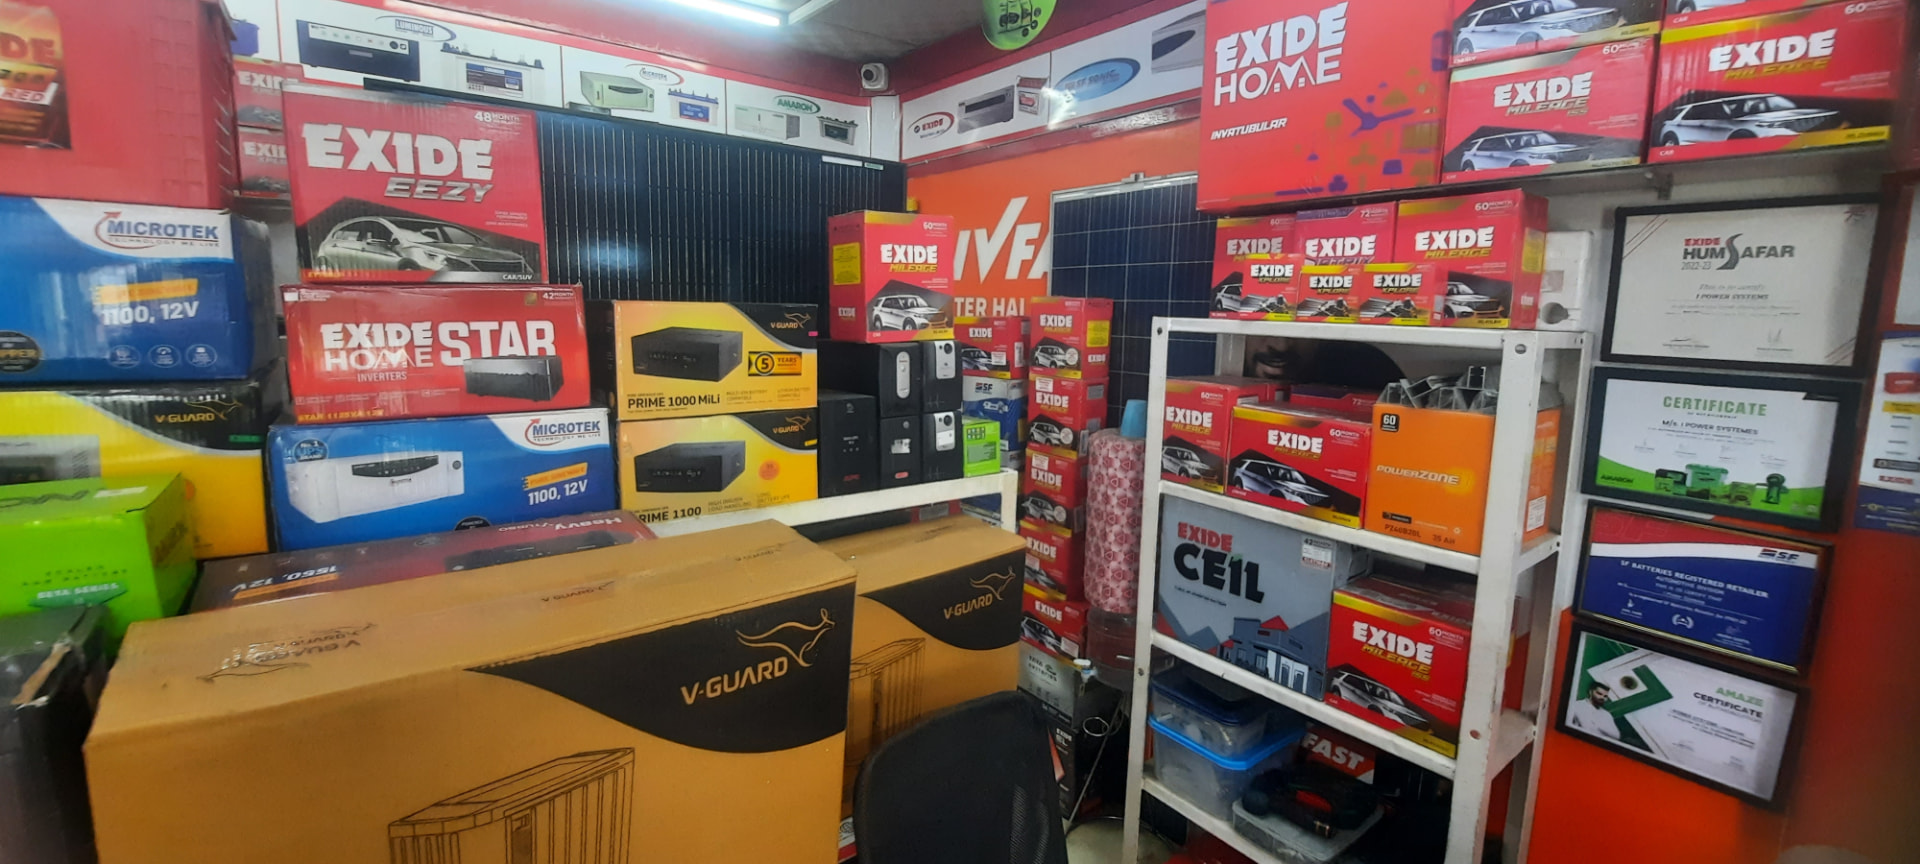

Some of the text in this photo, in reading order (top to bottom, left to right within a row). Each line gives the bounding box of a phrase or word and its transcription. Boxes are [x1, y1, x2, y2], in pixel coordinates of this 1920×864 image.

[396, 18, 434, 36] LUMINOUS
[1215, 2, 1348, 74] EXIDE
[1602, 43, 1618, 55] 60
[1709, 28, 1838, 72] EXIDE
[1214, 48, 1343, 106] HOME
[1725, 56, 1830, 80] MILEAGE
[1494, 71, 1594, 108] EXIDE
[777, 98, 812, 112] AMARON
[1505, 96, 1589, 116] MILEAGE
[474, 111, 492, 122] 48
[1210, 117, 1288, 141] INVATUBULAR
[302, 123, 493, 180] EXIDE
[384, 177, 493, 203] EEZY
[1475, 202, 1489, 211] 60
[107, 220, 219, 240] MICROTEK
[923, 222, 933, 230] 60
[1227, 237, 1283, 255] EXIDE
[1305, 234, 1377, 257] EXIDE
[1415, 226, 1495, 251] EXIDE
[1684, 237, 1721, 247] EXIDE
[880, 244, 938, 264] EXIDE
[1424, 248, 1492, 259] MILEAGE
[889, 264, 938, 273] MILEAGE
[1251, 264, 1294, 277] EXIDE
[1309, 275, 1353, 289] EXIDE
[1373, 274, 1422, 288] EXIDE
[543, 292, 554, 300] 42
[101, 301, 199, 327] 1100, 12V
[1040, 314, 1073, 328] EXIDE
[969, 327, 993, 339] EXIDE
[320, 319, 556, 367] EXIDE STAR
[325, 347, 434, 372] HOME
[760, 358, 769, 370] 5
[357, 371, 408, 383] INVERTERS
[983, 383, 993, 391] SF
[628, 397, 665, 409] PRIME
[668, 395, 697, 407] 1000
[1035, 392, 1069, 408] EXIDE
[1663, 396, 1768, 417] CERTIFICATE
[155, 413, 215, 423] V-GUARD
[1166, 406, 1213, 428] EXIDE
[1383, 415, 1397, 426] 60
[533, 420, 600, 436] MICROTEK
[1171, 423, 1212, 435] MILEAGE
[1329, 429, 1341, 437] 60
[1267, 429, 1324, 454] EXIDE
[1031, 468, 1062, 487] EXIDE
[1376, 464, 1459, 485] POWERZONE
[528, 479, 588, 506] 1100, 12V
[554, 517, 622, 531] Heavy
[638, 507, 702, 523] RIME 1100
[1178, 522, 1233, 552] EXIDE
[1304, 538, 1313, 546] 42
[1432, 534, 1442, 543] 35
[1026, 536, 1057, 558] EXIDE
[1776, 551, 1800, 561] SF
[1174, 542, 1265, 603] CEIL
[1631, 562, 1673, 577] BATTERIES
[1674, 572, 1725, 588] REGISTERED
[1726, 584, 1768, 598] RETAILER
[943, 593, 993, 620] V-GUARD
[1035, 600, 1062, 621] EXIDE
[1429, 627, 1441, 637] 60
[1352, 620, 1435, 665] EXIDE
[1362, 644, 1432, 675] MILEAGE
[680, 656, 788, 705] V-GUARD
[1693, 692, 1764, 718] CERTIFICATE
[1716, 687, 1764, 707] AMAZE
[1303, 730, 1366, 770] FAST
